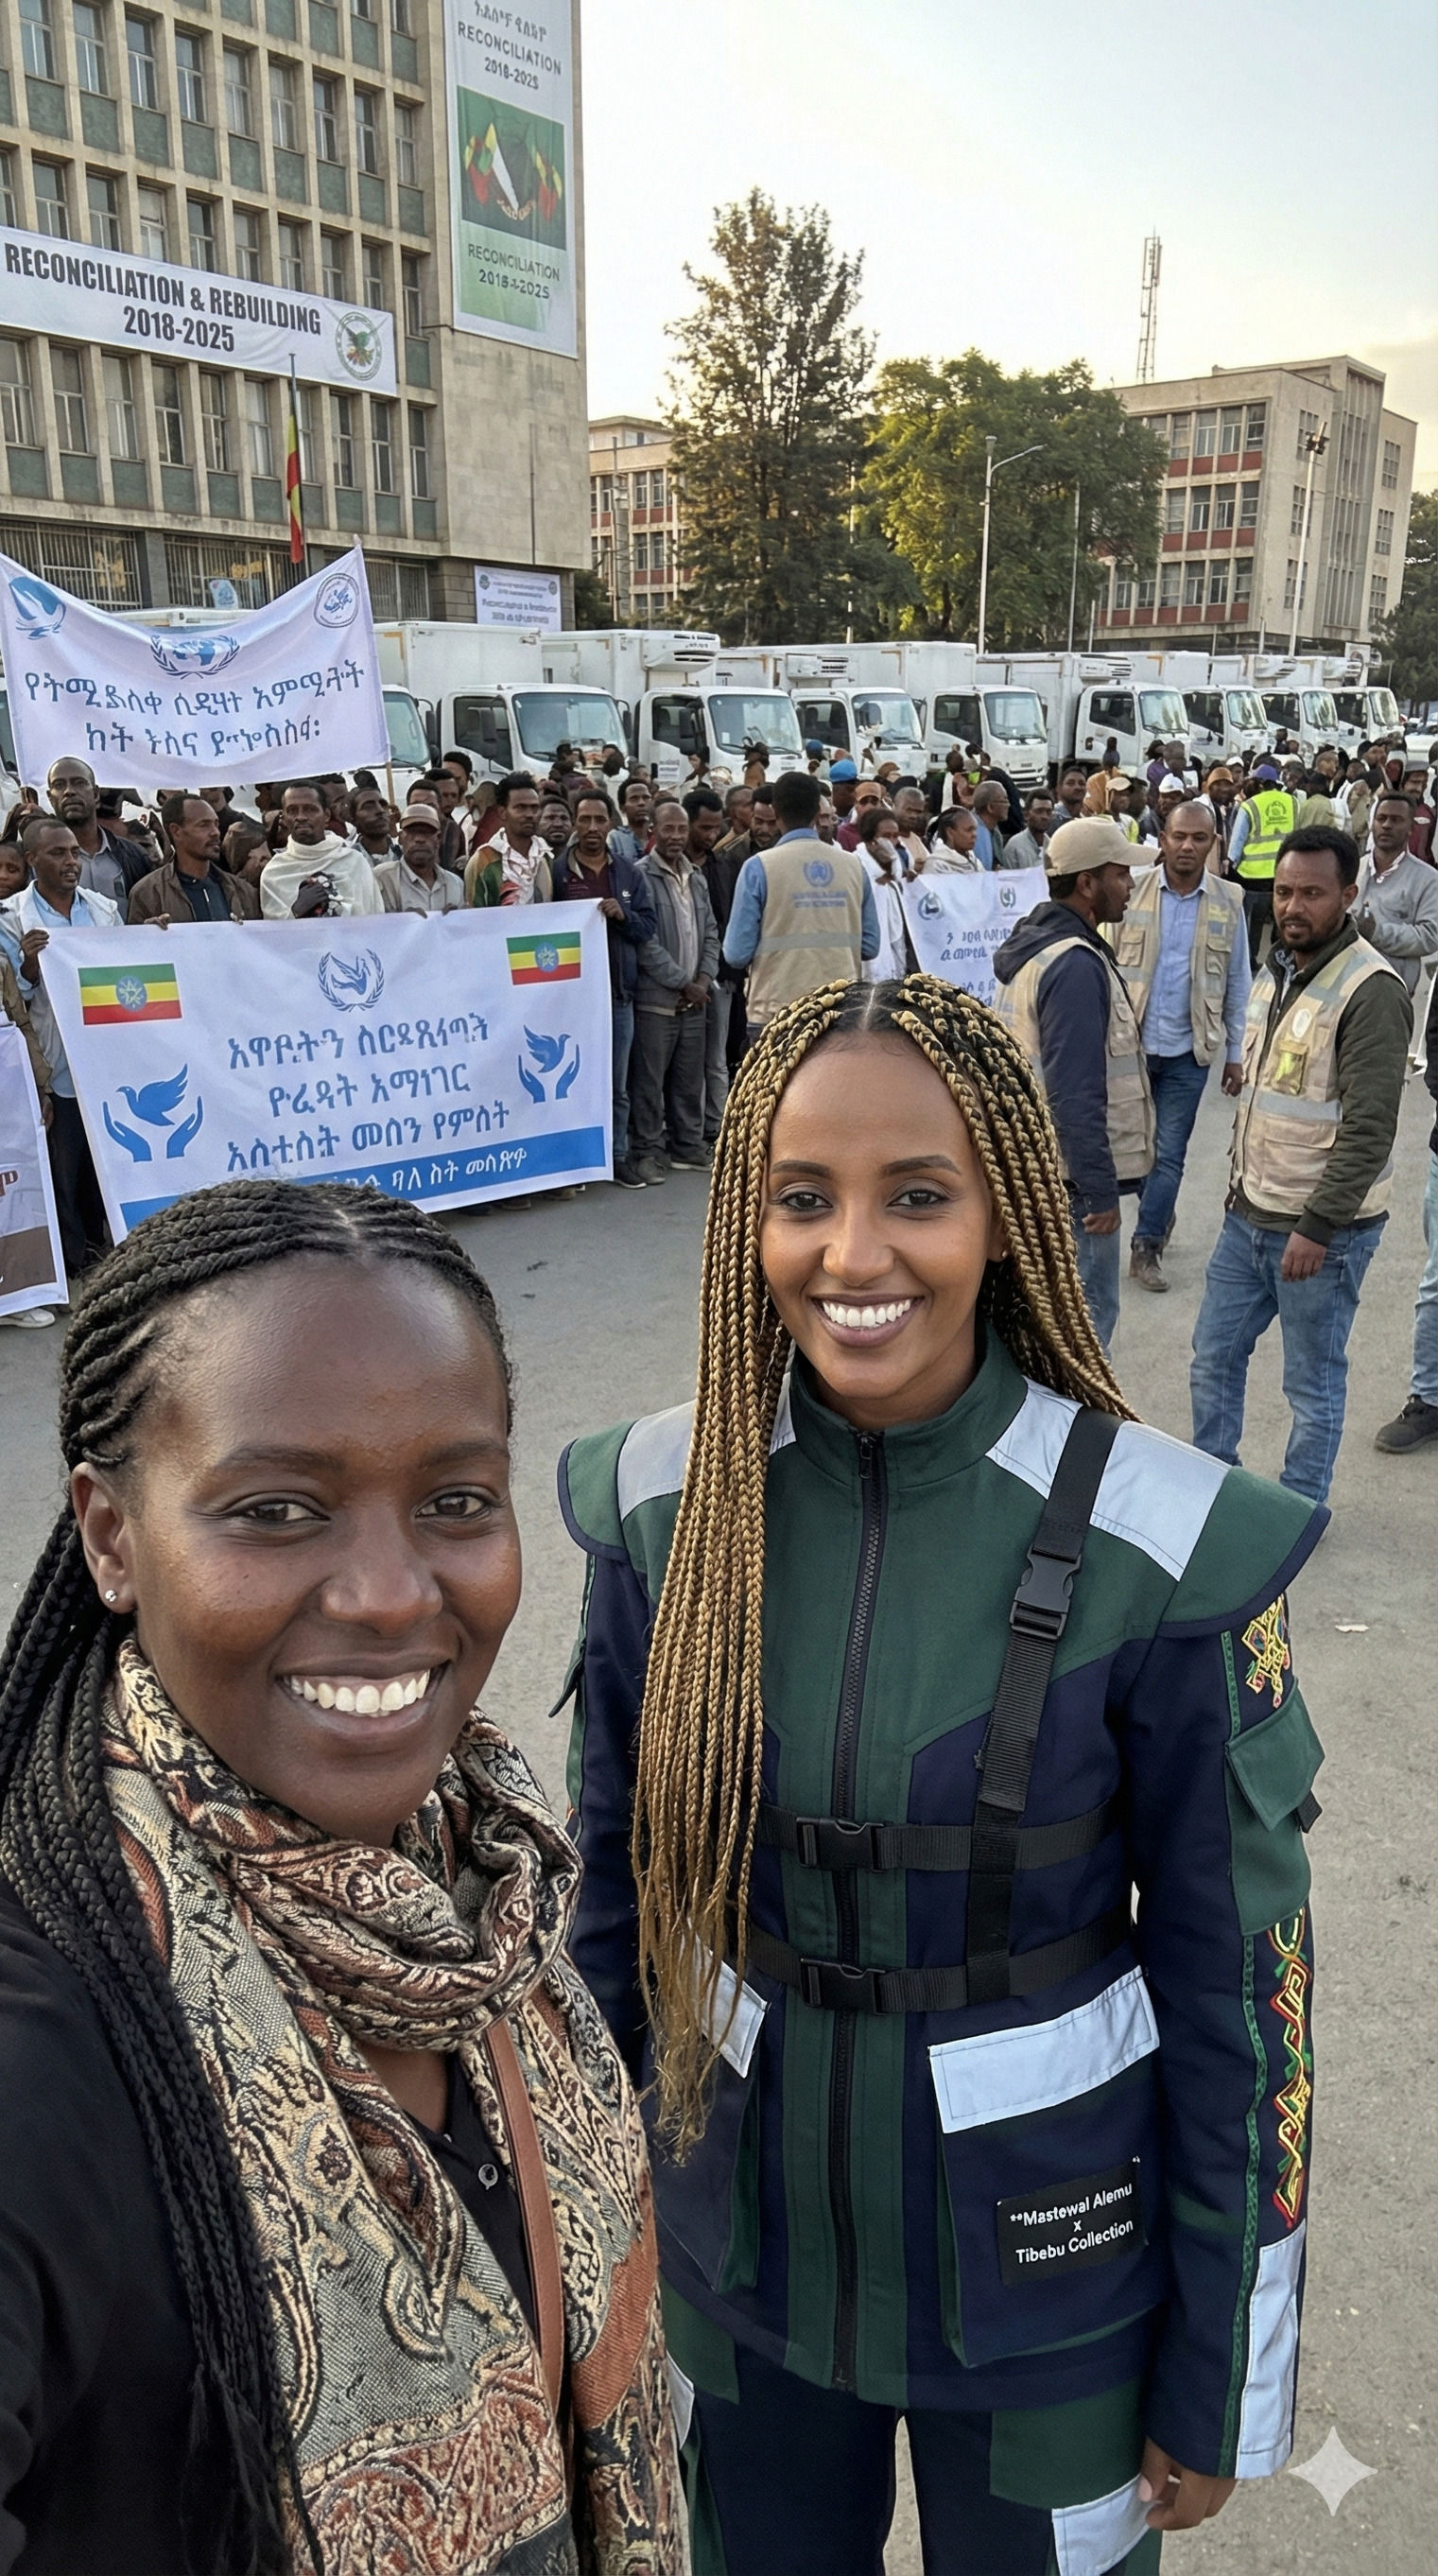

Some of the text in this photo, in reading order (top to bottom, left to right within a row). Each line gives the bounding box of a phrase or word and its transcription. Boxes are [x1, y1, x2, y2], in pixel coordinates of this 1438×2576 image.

[458, 21, 561, 76] RECONCILIATION
[468, 243, 560, 282] RECONCILIATION
[4, 242, 321, 335] RECONCILIATION & REBUILDING
[123, 305, 234, 352] 2018-2025
[1093, 2183, 1133, 2209] Alemu
[1015, 2220, 1134, 2264] Tibebu Collection
